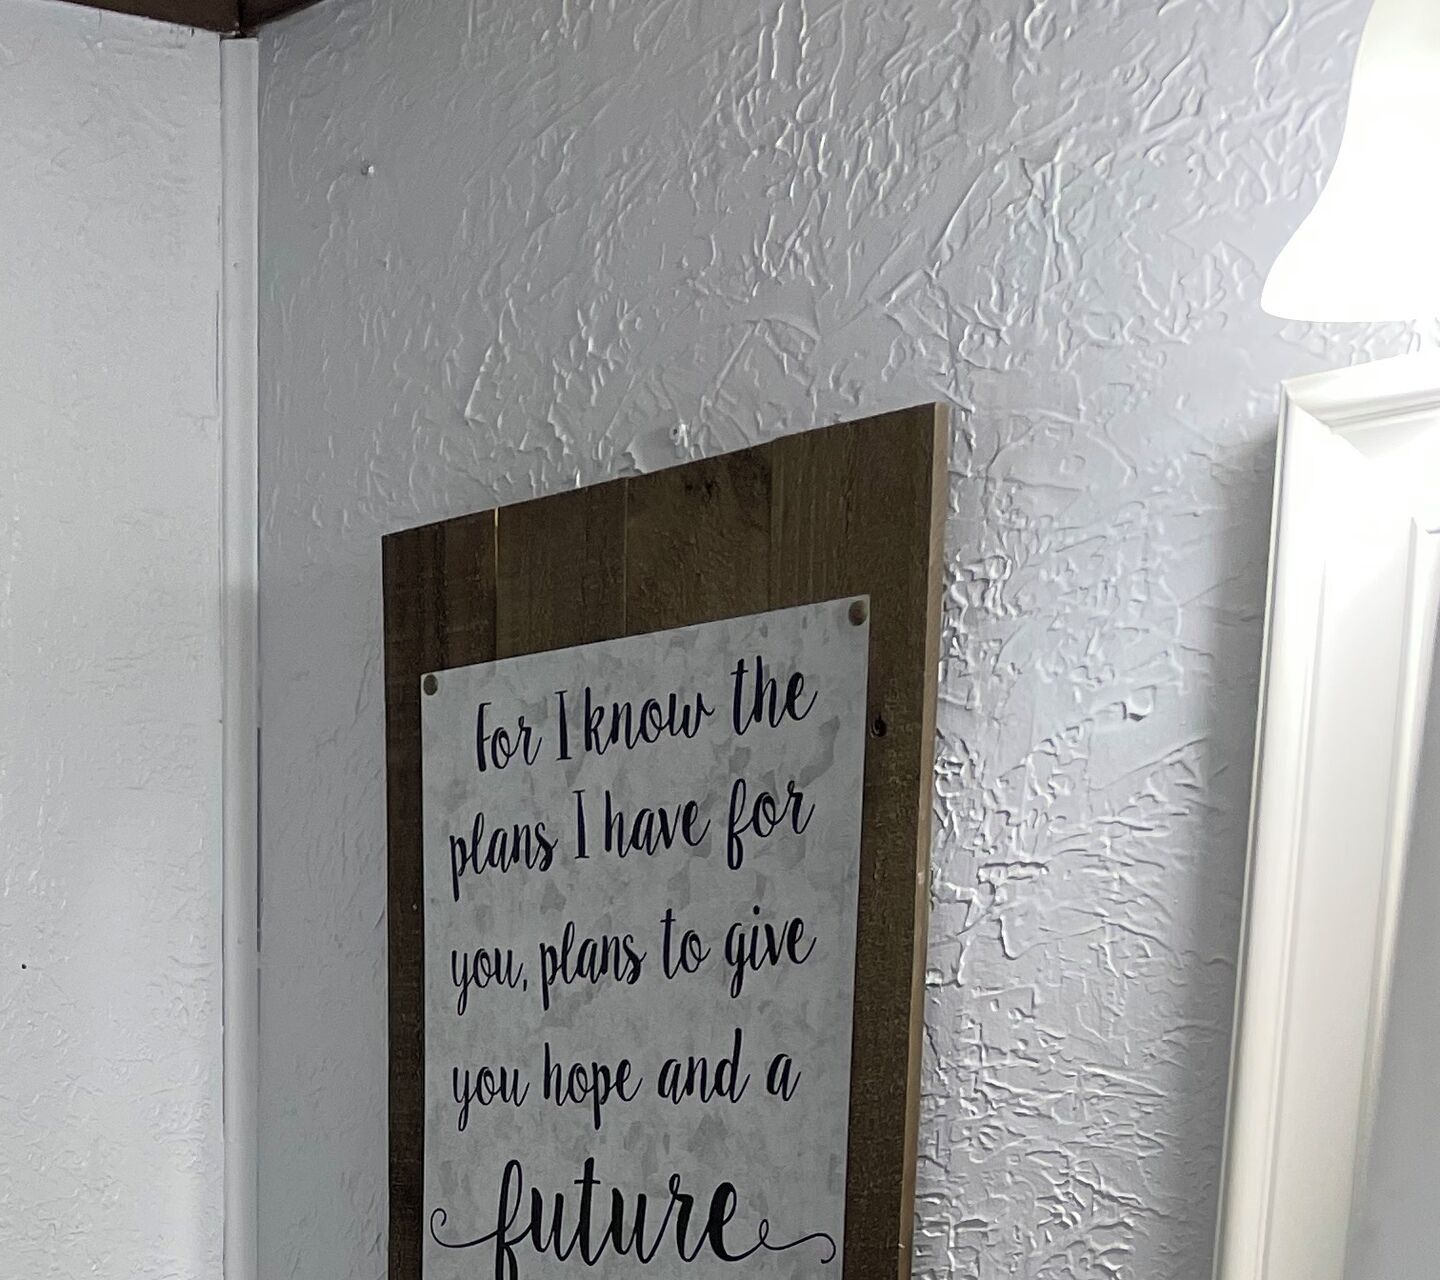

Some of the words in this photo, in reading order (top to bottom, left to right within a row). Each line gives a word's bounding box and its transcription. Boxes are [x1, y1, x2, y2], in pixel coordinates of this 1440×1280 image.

[476, 701, 542, 772] For
[555, 689, 573, 761] I
[585, 687, 715, 756] know
[730, 655, 818, 736] the
[449, 812, 558, 902] plans
[572, 789, 590, 860] I
[605, 789, 711, 859] have
[727, 778, 816, 871] for
[451, 947, 528, 1017] you,
[540, 920, 647, 1012] plans
[660, 907, 711, 980] to
[725, 905, 817, 999] give
[452, 1066, 530, 1132] you
[543, 1042, 643, 1130] hope
[657, 1027, 751, 1104] and
[766, 1053, 802, 1102] a
